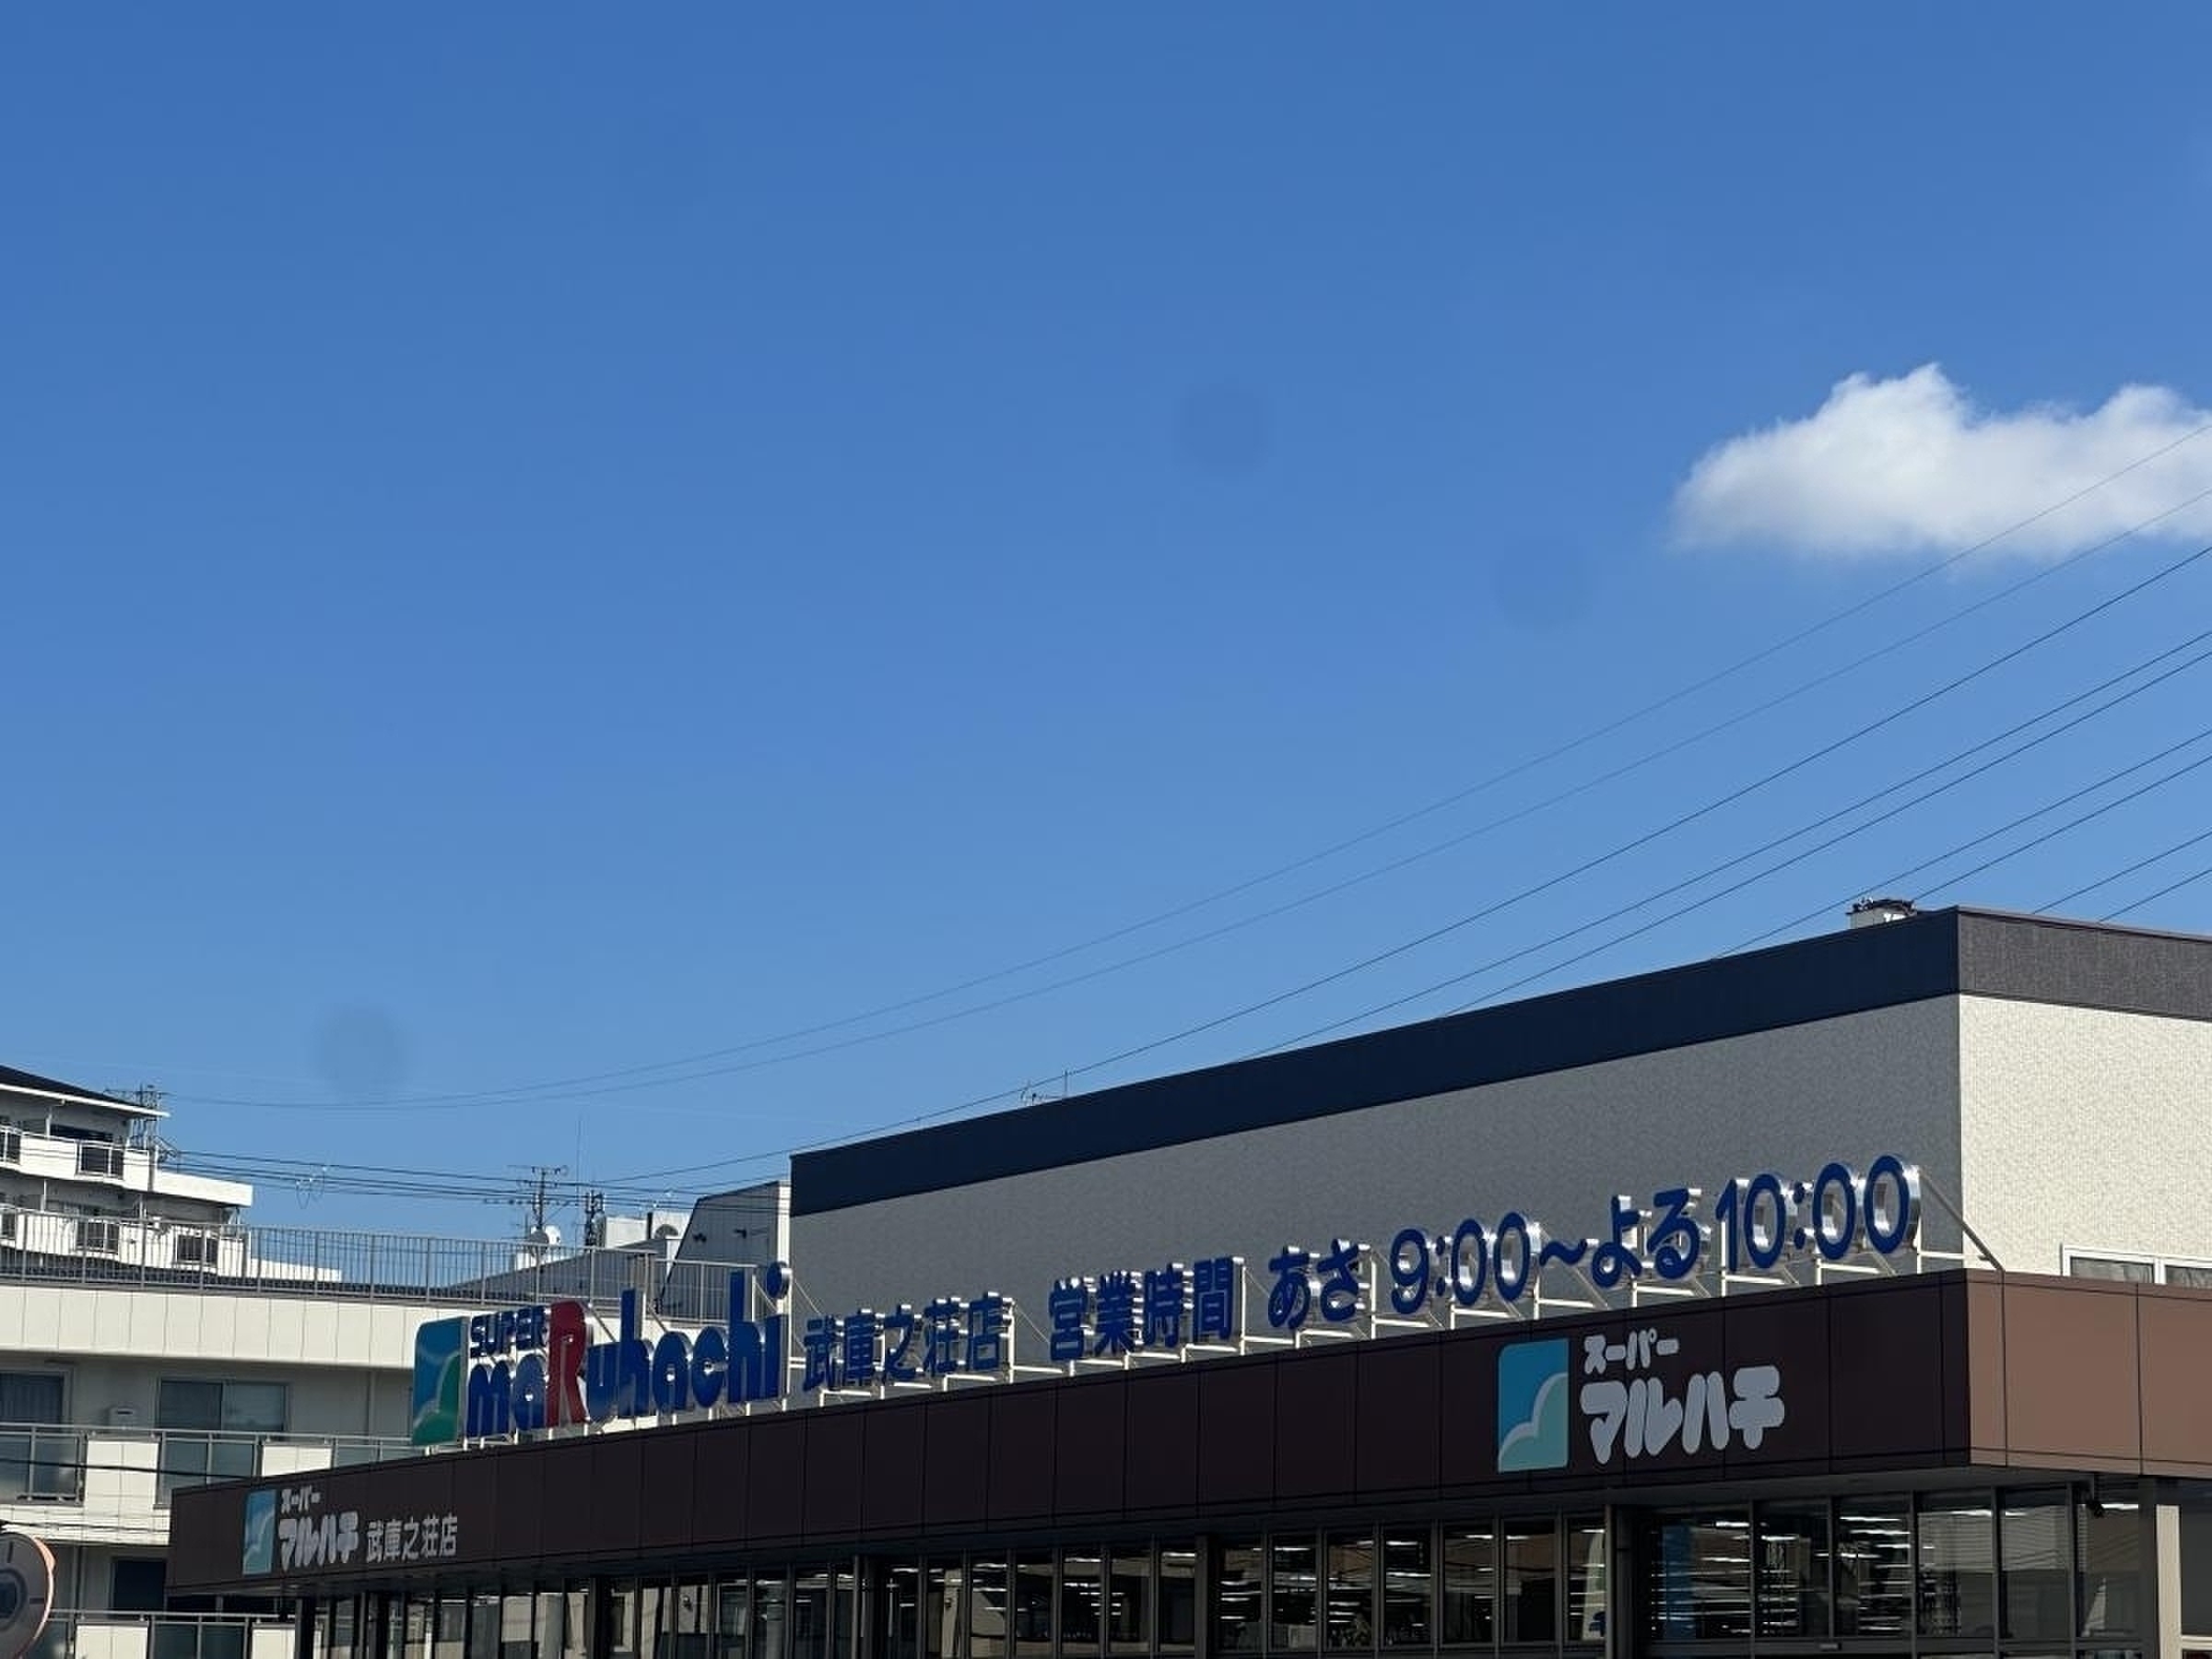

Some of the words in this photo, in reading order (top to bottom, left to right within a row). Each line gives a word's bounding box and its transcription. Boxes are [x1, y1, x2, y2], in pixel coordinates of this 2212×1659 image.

[803, 1292, 1005, 1393] 武庫之荘店
[1049, 1257, 1235, 1361] 営業時間
[1267, 1237, 1360, 1327] あさ
[1714, 1154, 1912, 1274] 10:00
[470, 1305, 547, 1359] SUPER
[1584, 1327, 1679, 1374] スーパー
[1580, 1365, 1785, 1465] マルハチ
[281, 1486, 321, 1513] スーパー
[278, 1511, 359, 1571] マルハチ
[366, 1512, 458, 1563] 武庫之荘店
